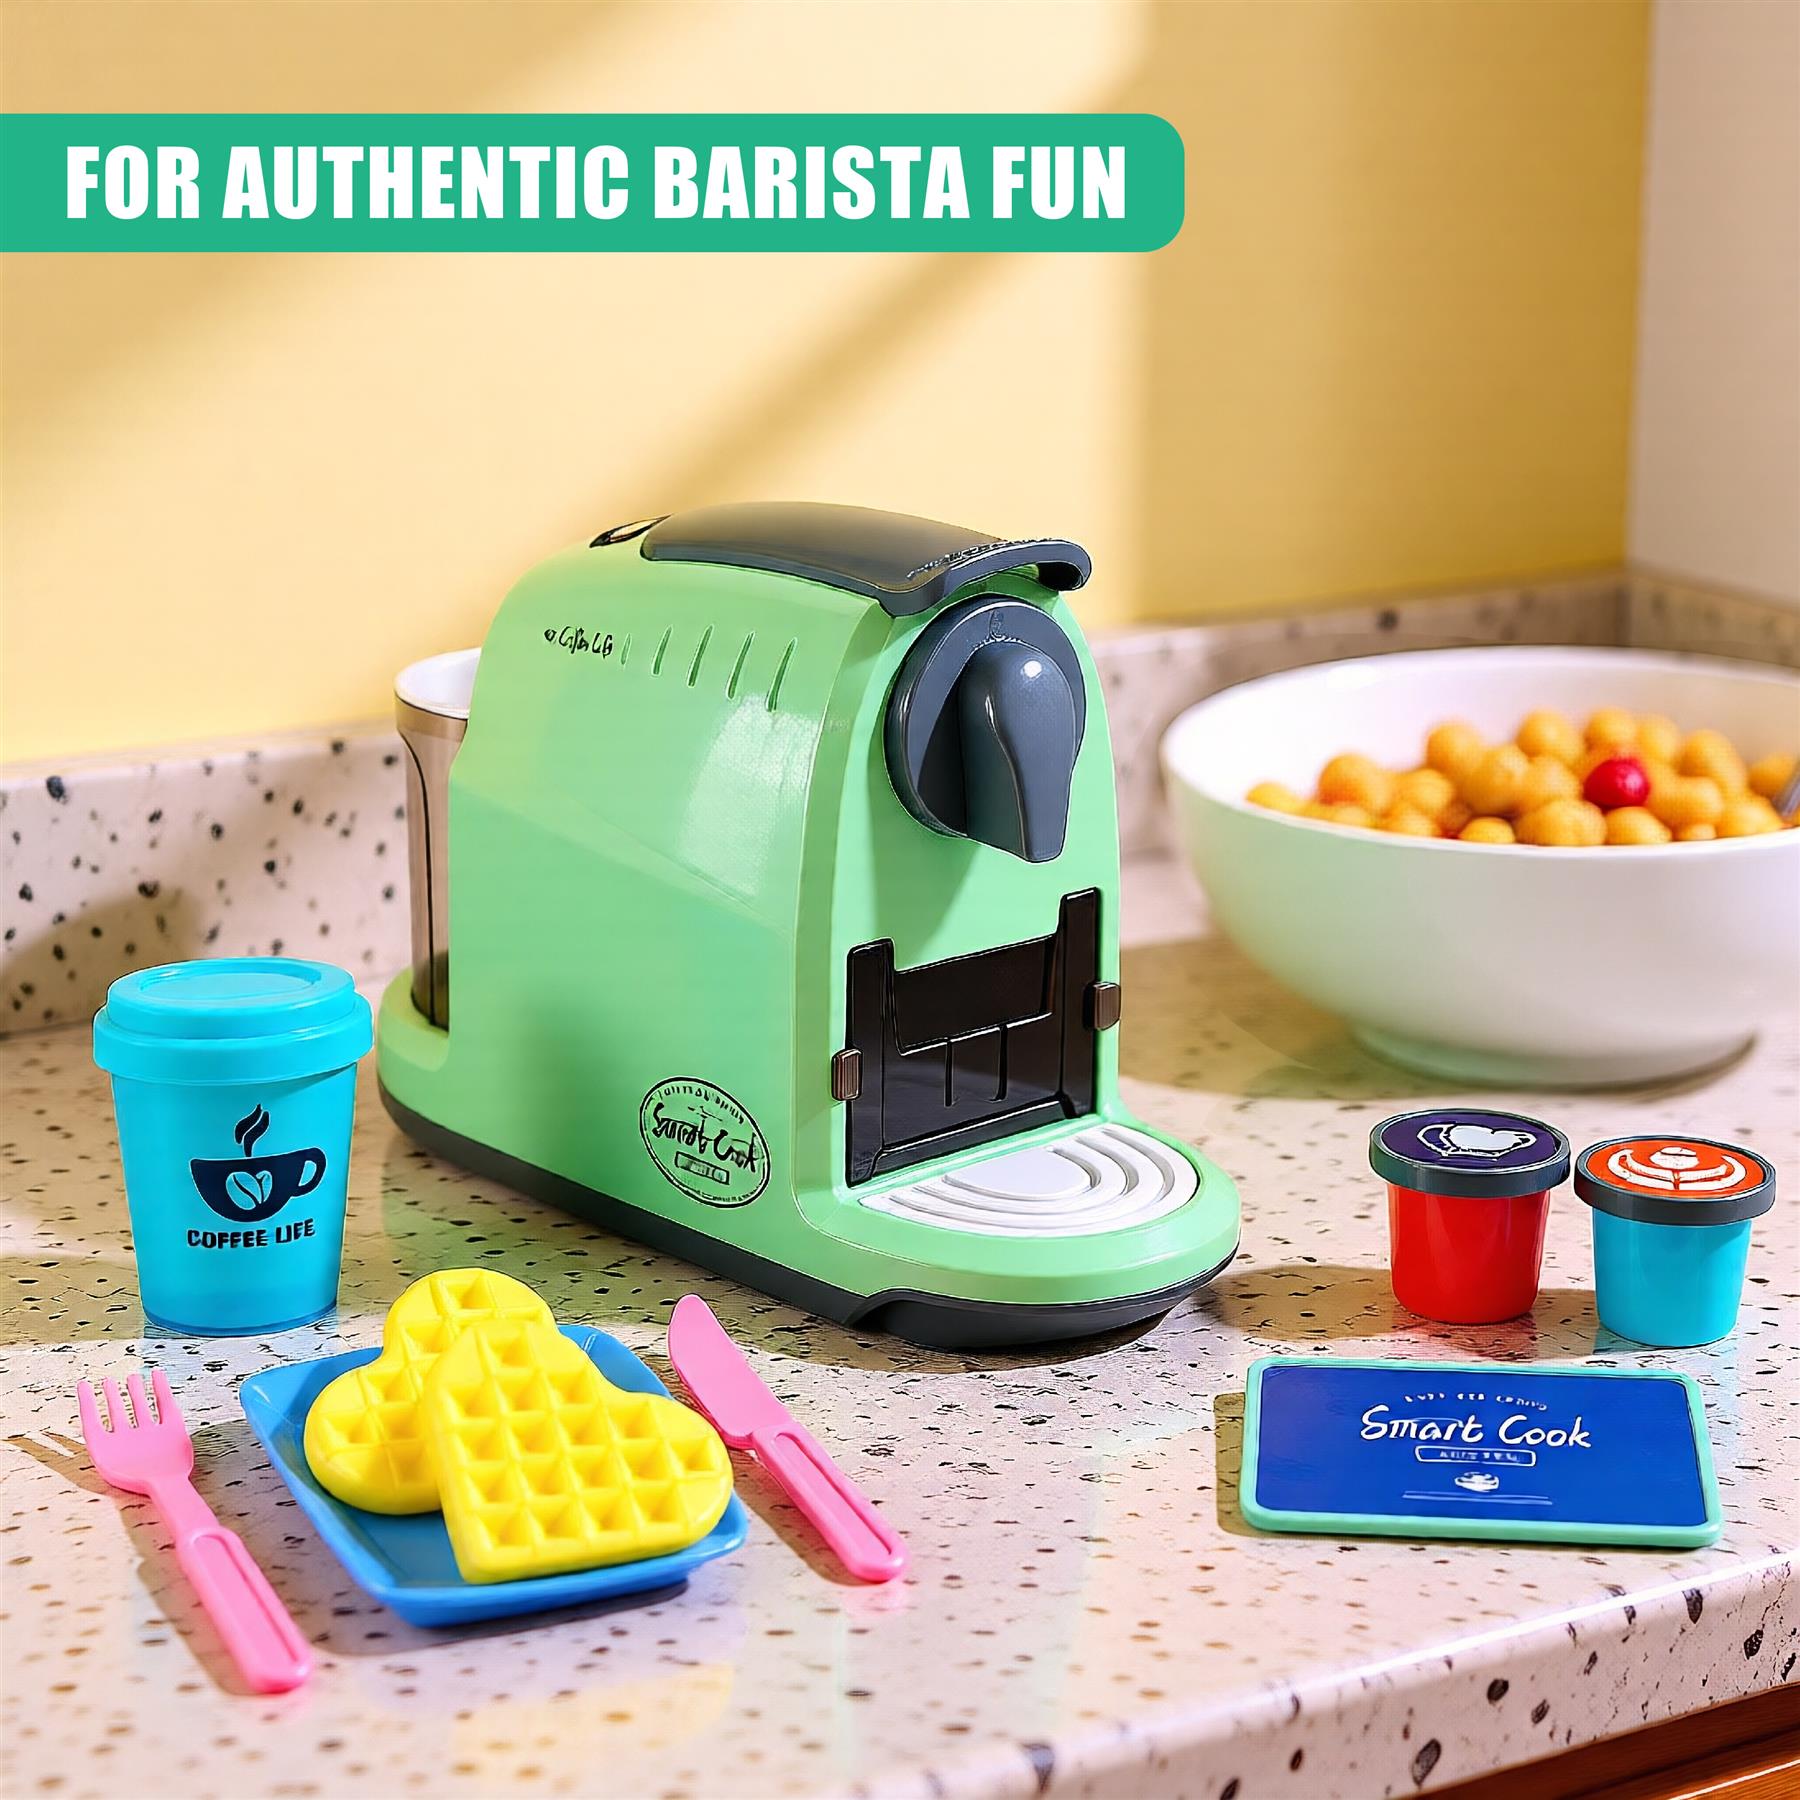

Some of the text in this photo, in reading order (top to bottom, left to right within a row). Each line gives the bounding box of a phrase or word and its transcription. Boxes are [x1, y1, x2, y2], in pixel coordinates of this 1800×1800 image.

[187, 1218, 316, 1249] COFFEE LIFE
[1360, 1404, 1592, 1448] Smart Cook
